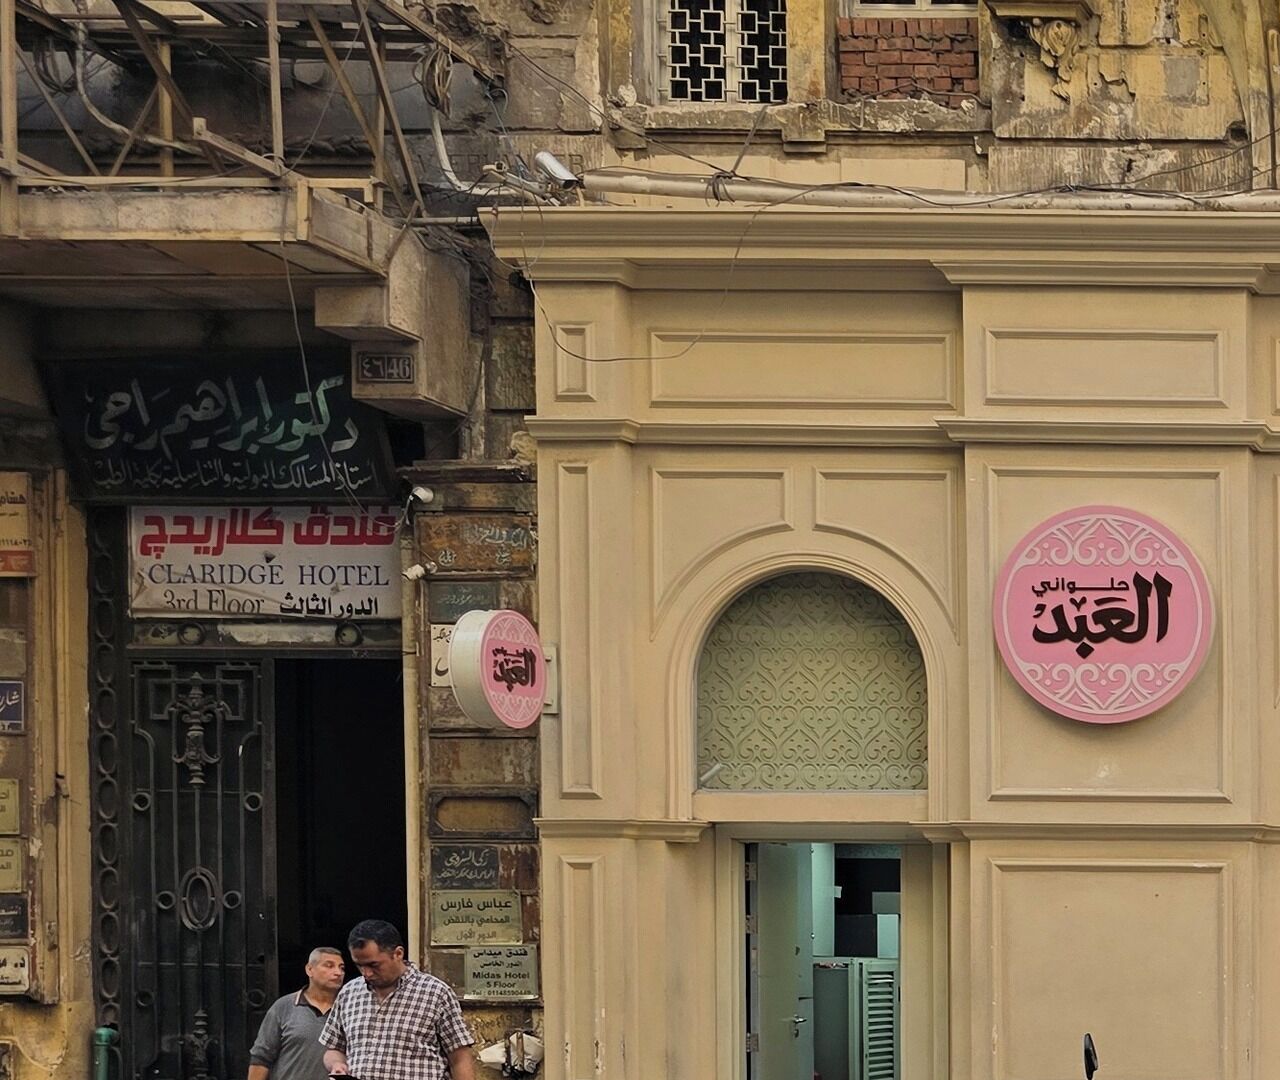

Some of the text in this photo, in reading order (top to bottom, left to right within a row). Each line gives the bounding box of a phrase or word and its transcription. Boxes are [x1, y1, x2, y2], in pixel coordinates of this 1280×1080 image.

[388, 358, 410, 378] 46
[274, 375, 359, 452] دكتور
[293, 505, 397, 546] فندق
[148, 564, 390, 586] CLARIDGE HOTEL
[1031, 577, 1130, 598] حلواني
[163, 589, 265, 614] 3rd Floor
[279, 592, 379, 618] الدور الثالث
[1031, 571, 1173, 660] العبد
[493, 648, 537, 692] العبد
[440, 898, 512, 911] عباس فارس
[506, 949, 528, 958] فندق
